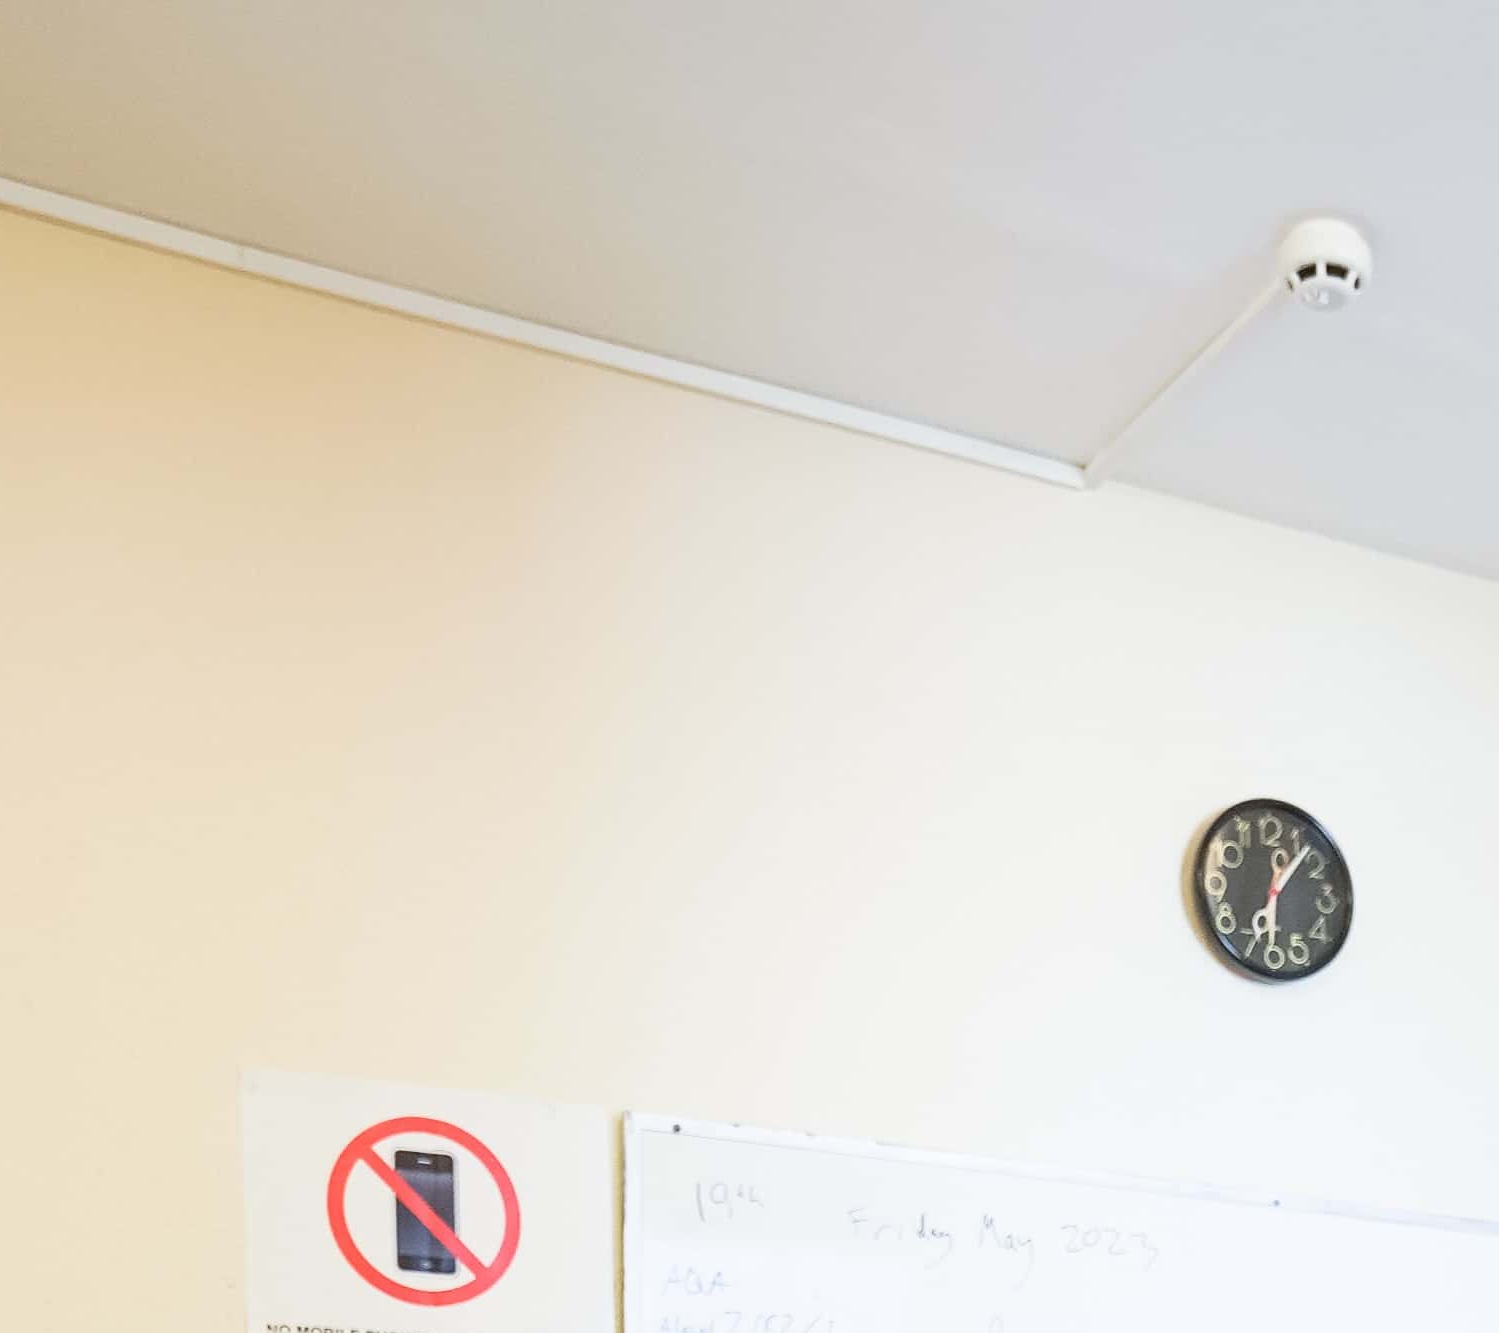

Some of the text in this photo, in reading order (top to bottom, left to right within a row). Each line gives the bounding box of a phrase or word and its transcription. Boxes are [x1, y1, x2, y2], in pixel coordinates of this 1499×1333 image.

[1306, 849, 1329, 880] 2
[1204, 870, 1228, 902] 9
[1315, 882, 1338, 915] 3
[1215, 901, 1237, 935] 8
[1308, 914, 1334, 944] 4
[1287, 931, 1310, 965] 5
